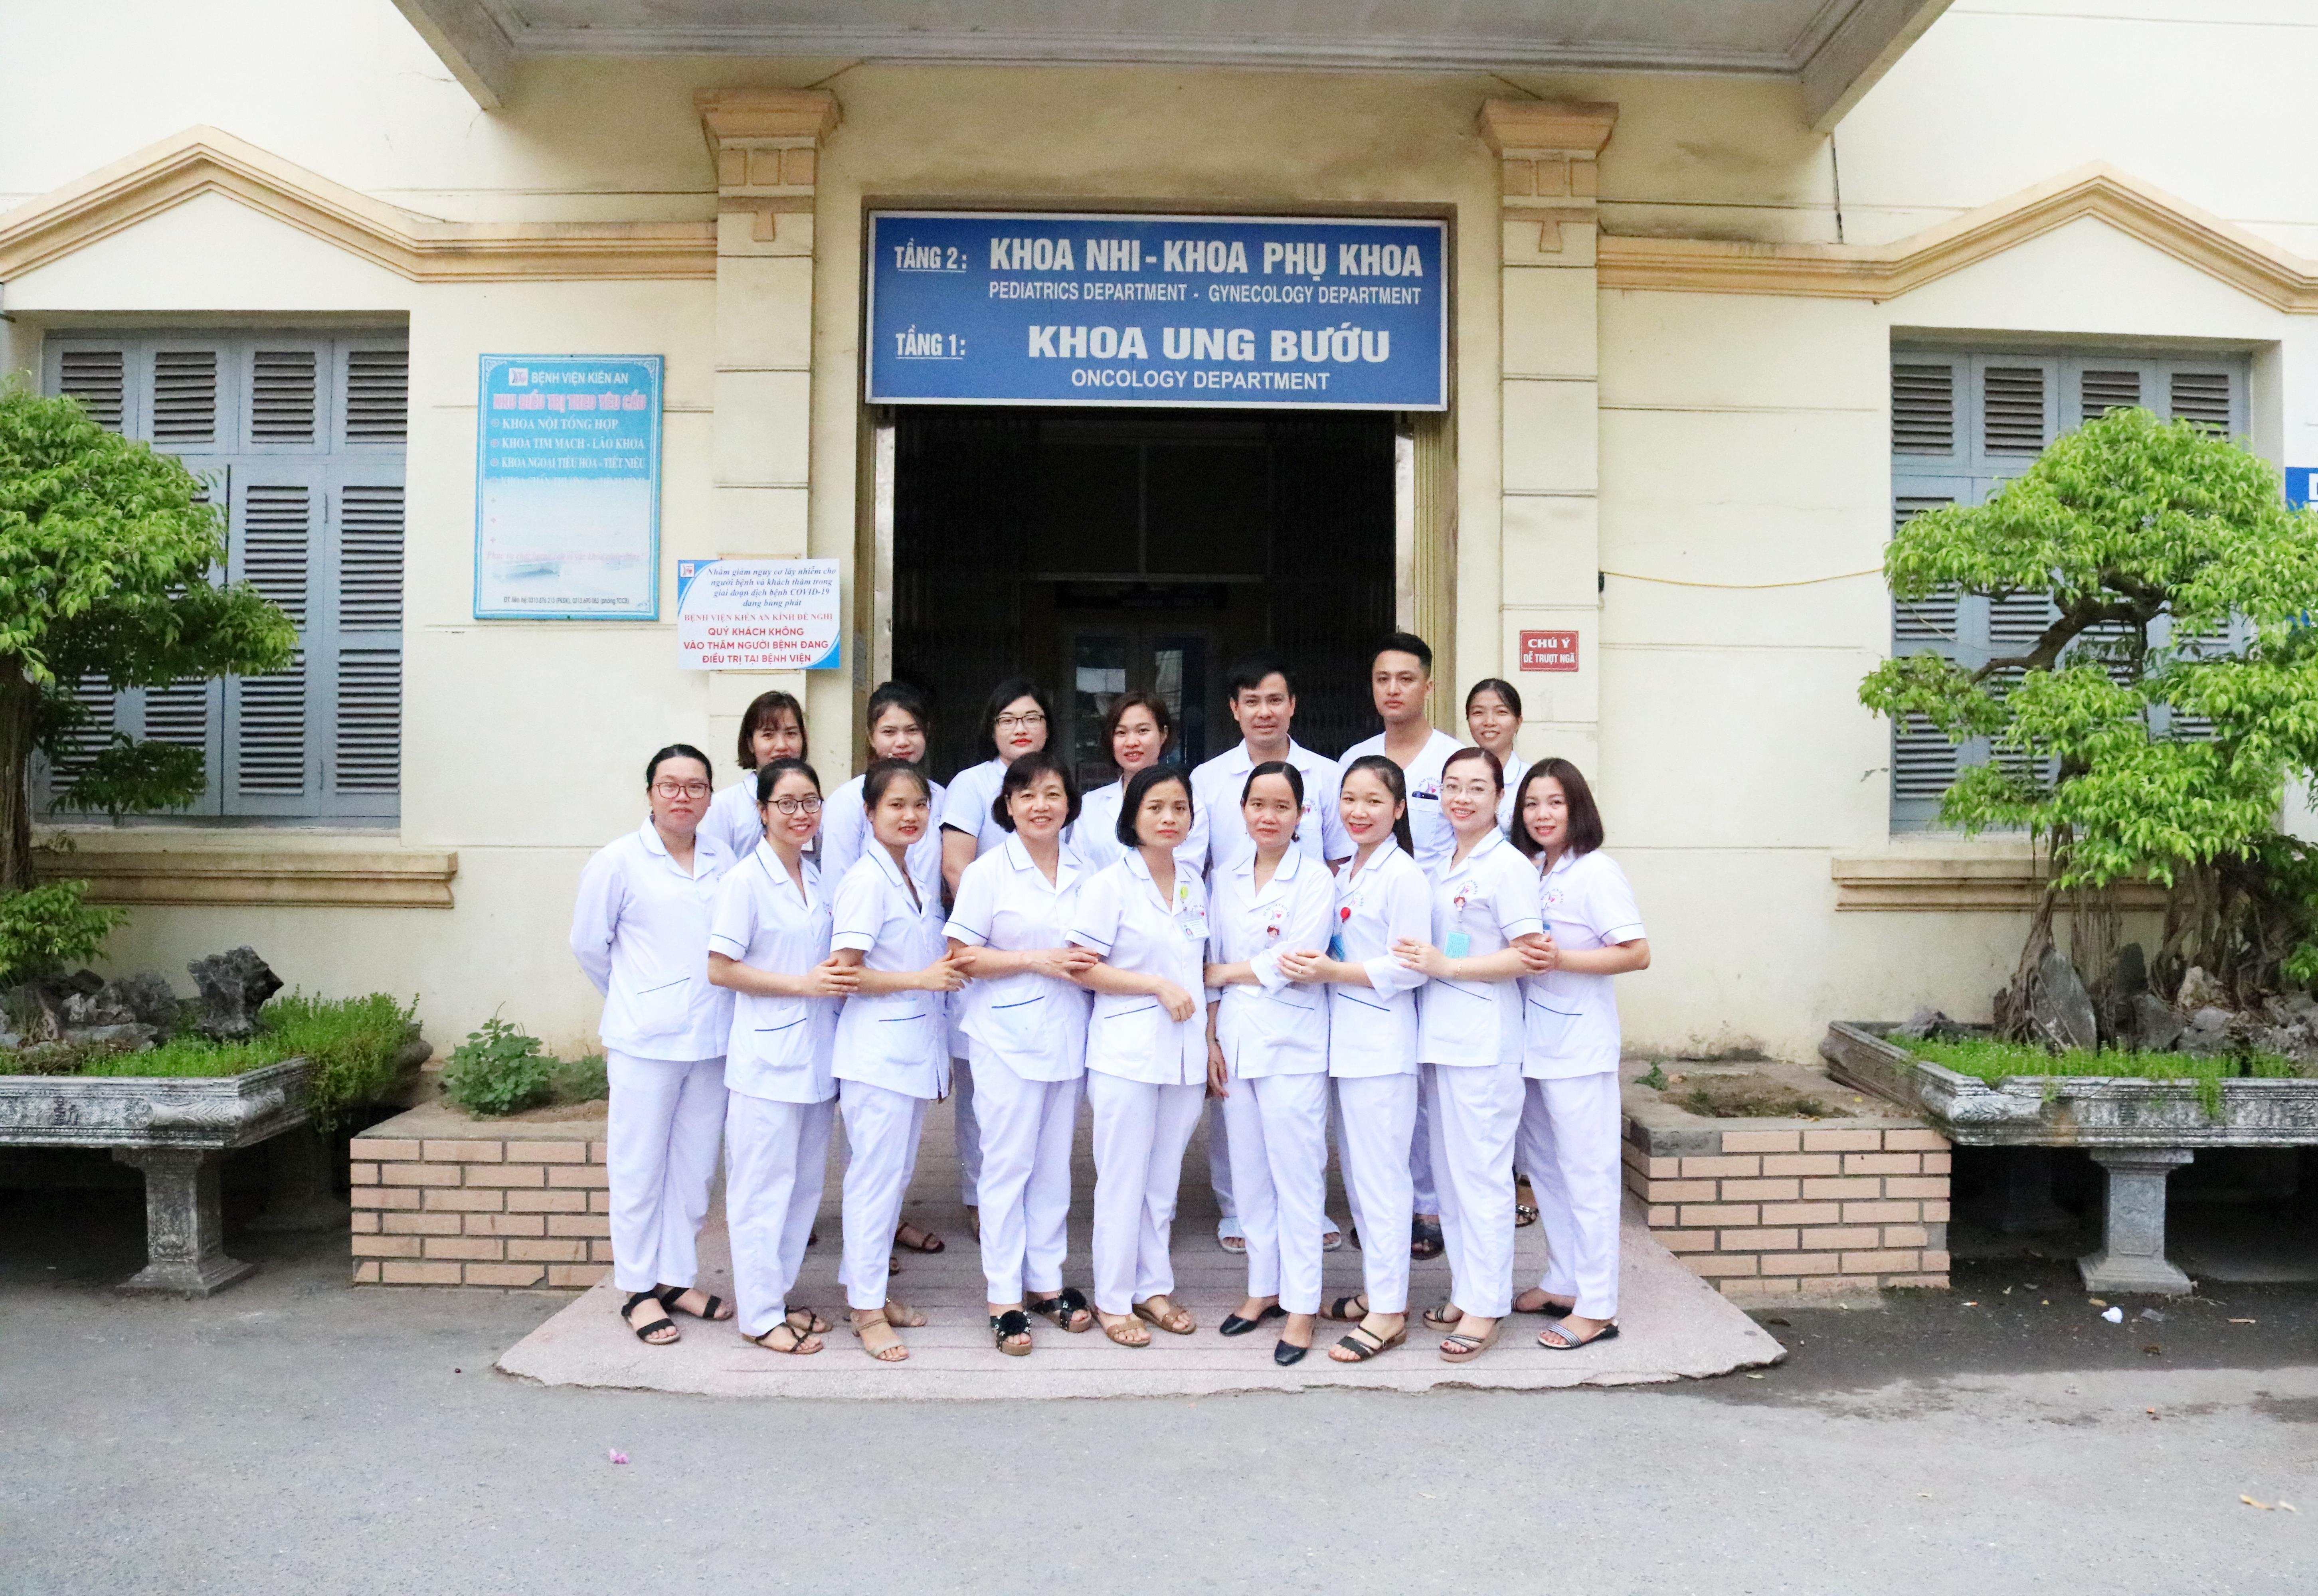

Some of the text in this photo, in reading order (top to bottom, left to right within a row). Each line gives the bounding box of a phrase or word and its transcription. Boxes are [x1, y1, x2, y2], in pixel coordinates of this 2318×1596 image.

[894, 238, 941, 269] TẦNG
[990, 238, 1074, 270] KHOA
[1086, 239, 1140, 271] NHI
[1164, 240, 1248, 274] KHOA
[1264, 242, 1326, 281] PHỤ
[1339, 244, 1423, 277] KHOA
[989, 281, 1078, 300] PEDIATRICS
[1084, 283, 1187, 301] DEPARTMENT
[1208, 284, 1313, 303] GYNECOLOGY
[1319, 286, 1422, 304] DEPARTMENT
[895, 324, 942, 356] TẦNG
[1029, 325, 1148, 359] KHOA
[1163, 327, 1255, 360] UNG
[1271, 322, 1389, 363] BƯỚU
[531, 371, 560, 386] BỆNH
[562, 371, 585, 387] VIỆN
[613, 373, 629, 384] AN
[1071, 369, 1330, 389] ONCOLOGY DEPARTMENT
[502, 418, 535, 429] KHOA
[502, 437, 531, 448] KHOA
[533, 437, 552, 449] TIM
[616, 438, 645, 449] KHOA
[502, 456, 526, 468] KHOA
[736, 579, 754, 587] bệnh
[730, 589, 748, 598] đoạn
[751, 589, 766, 597] dịch
[769, 589, 787, 597] bệnh
[784, 599, 801, 608] phát
[685, 614, 708, 622] BỆNH
[711, 614, 732, 622] VIỆN
[708, 626, 804, 636] QUÝ KHÁCH KHÔNG
[684, 640, 829, 651] VÀO THĂM NGƯỜI BỆNH ĐANG
[1527, 637, 1570, 648] CHÚ Ý
[728, 655, 742, 665] TRỊ
[744, 655, 758, 665] TẠI
[762, 653, 786, 664] BỆNH
[790, 653, 811, 664] VIỆN
